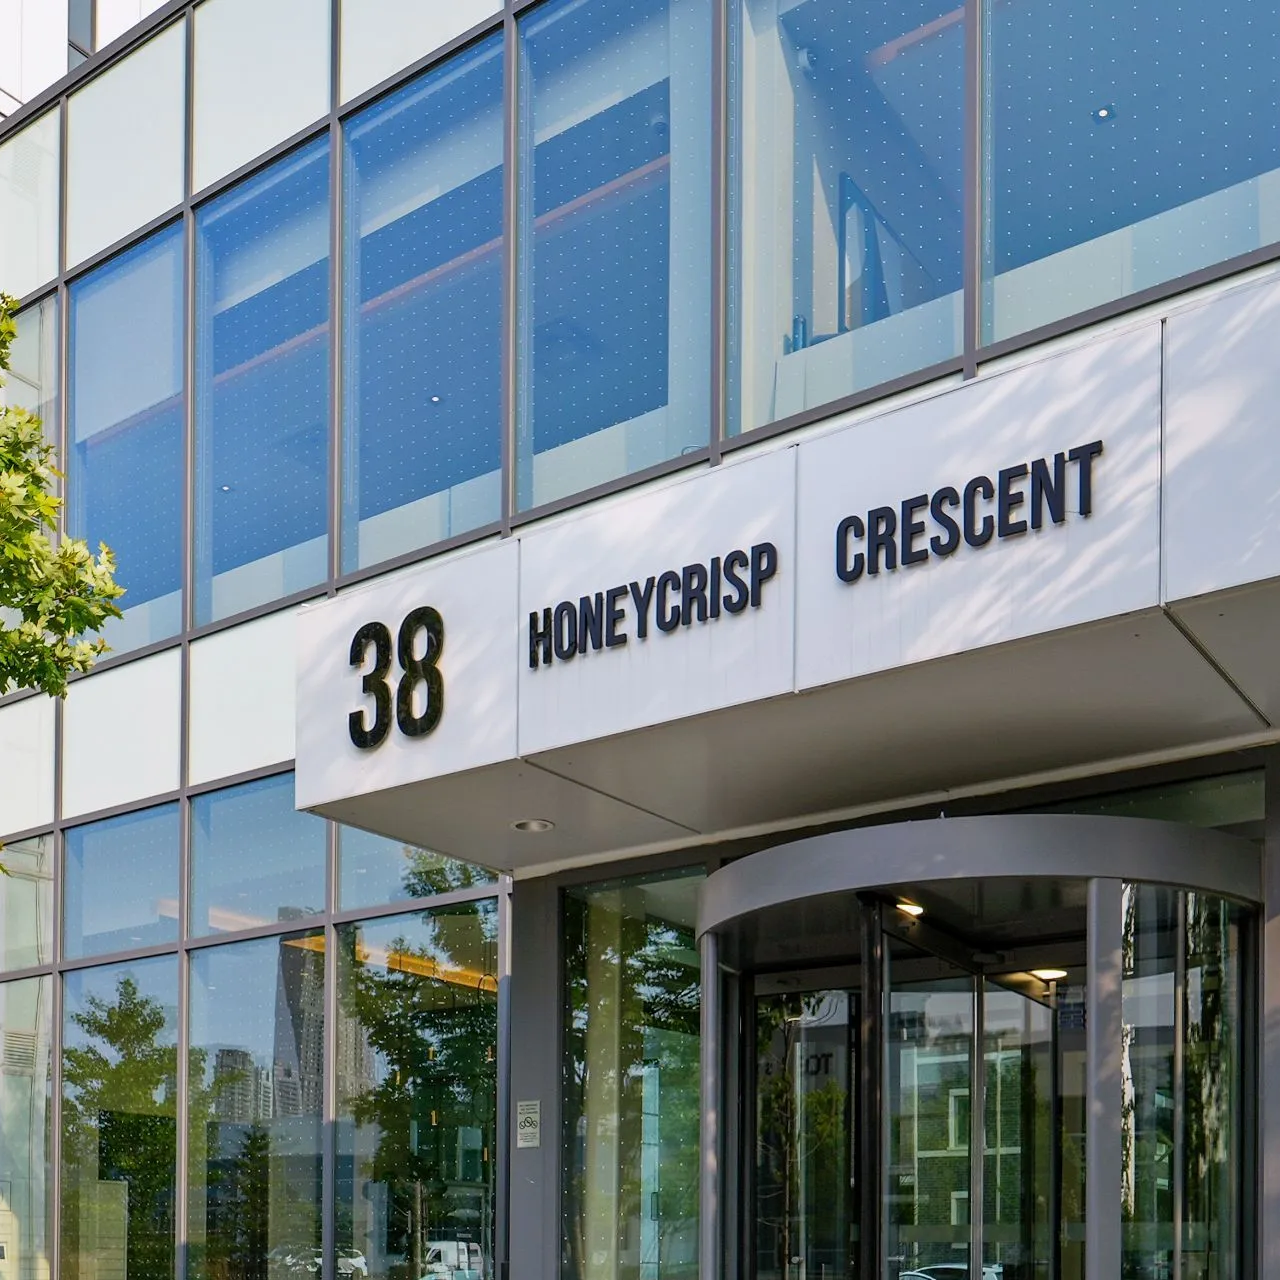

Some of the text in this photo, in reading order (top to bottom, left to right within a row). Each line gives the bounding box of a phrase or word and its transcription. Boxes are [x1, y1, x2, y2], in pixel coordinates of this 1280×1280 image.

[349, 606, 444, 748] 38
[529, 542, 777, 668] HONEYCRISP
[836, 440, 1103, 583] CRESCENT
